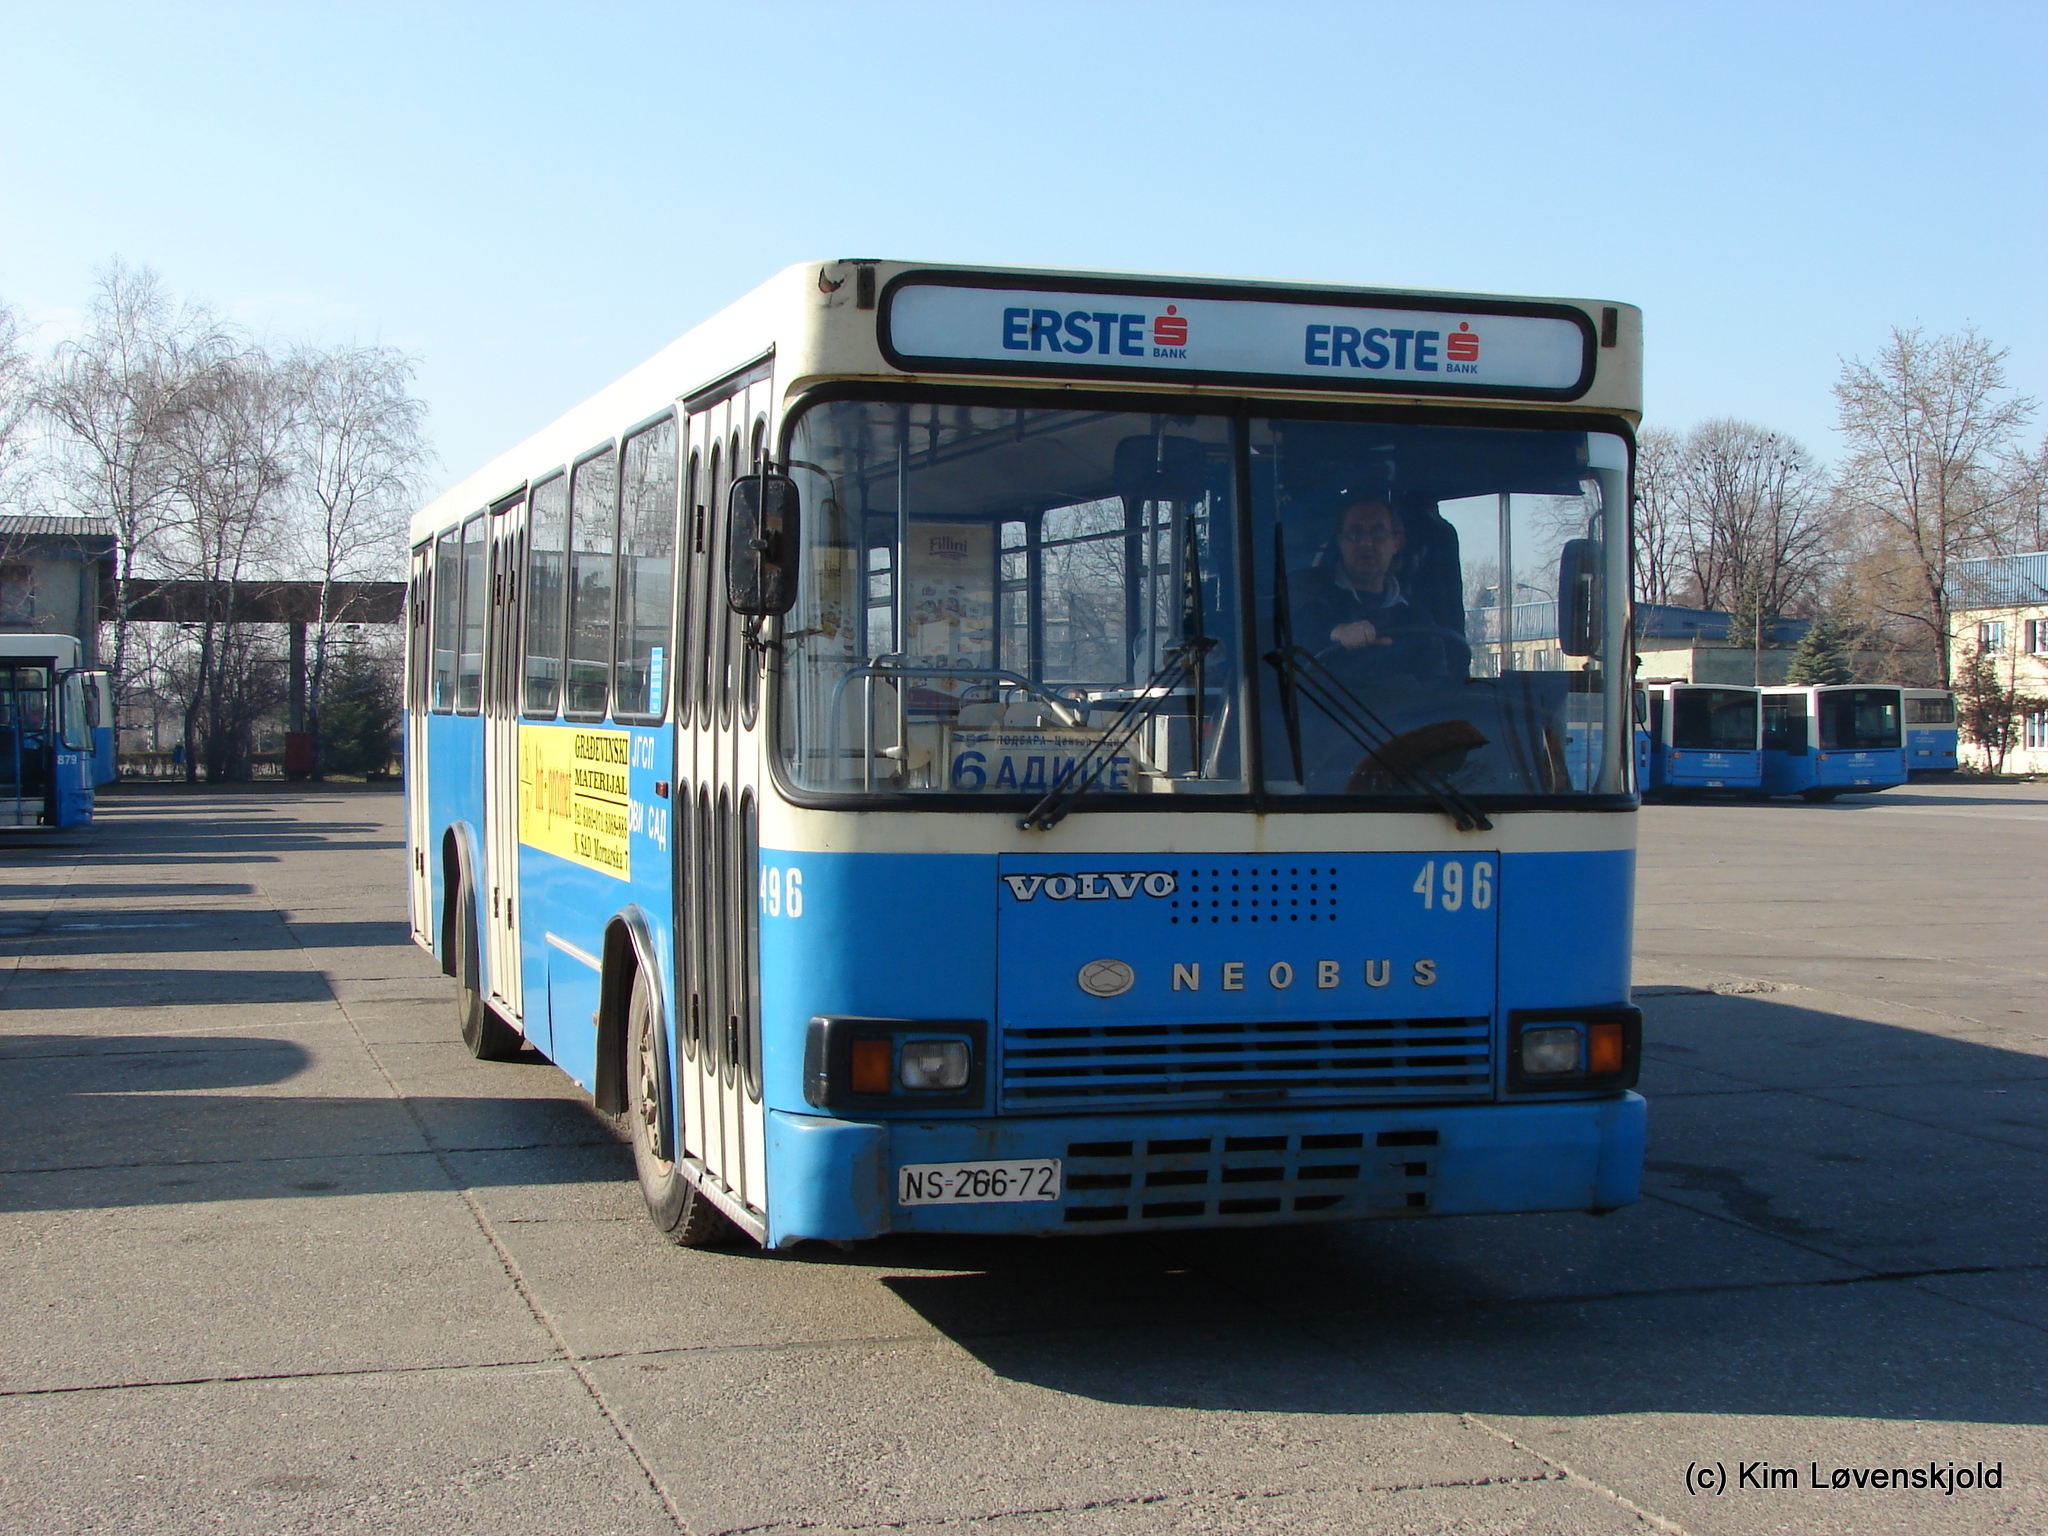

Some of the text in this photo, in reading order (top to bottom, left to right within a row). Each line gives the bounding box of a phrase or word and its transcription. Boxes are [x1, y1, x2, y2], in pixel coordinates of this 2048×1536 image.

[1003, 307, 1146, 357] ERSTE
[1305, 324, 1440, 372] ERSTE
[1153, 347, 1187, 359] BANK
[1446, 363, 1478, 375] BANK
[57, 754, 77, 765] 879
[575, 733, 629, 766] GRAĐEVINSKI
[574, 768, 628, 796] MATERIJAL
[952, 750, 1131, 793] 6 АДИЦЕ
[629, 798, 667, 852] ОВИ САД
[760, 864, 803, 918] 496
[1003, 872, 1176, 901] VOLVO
[1413, 861, 1493, 911] 496
[1172, 958, 1437, 991] NEOBUS
